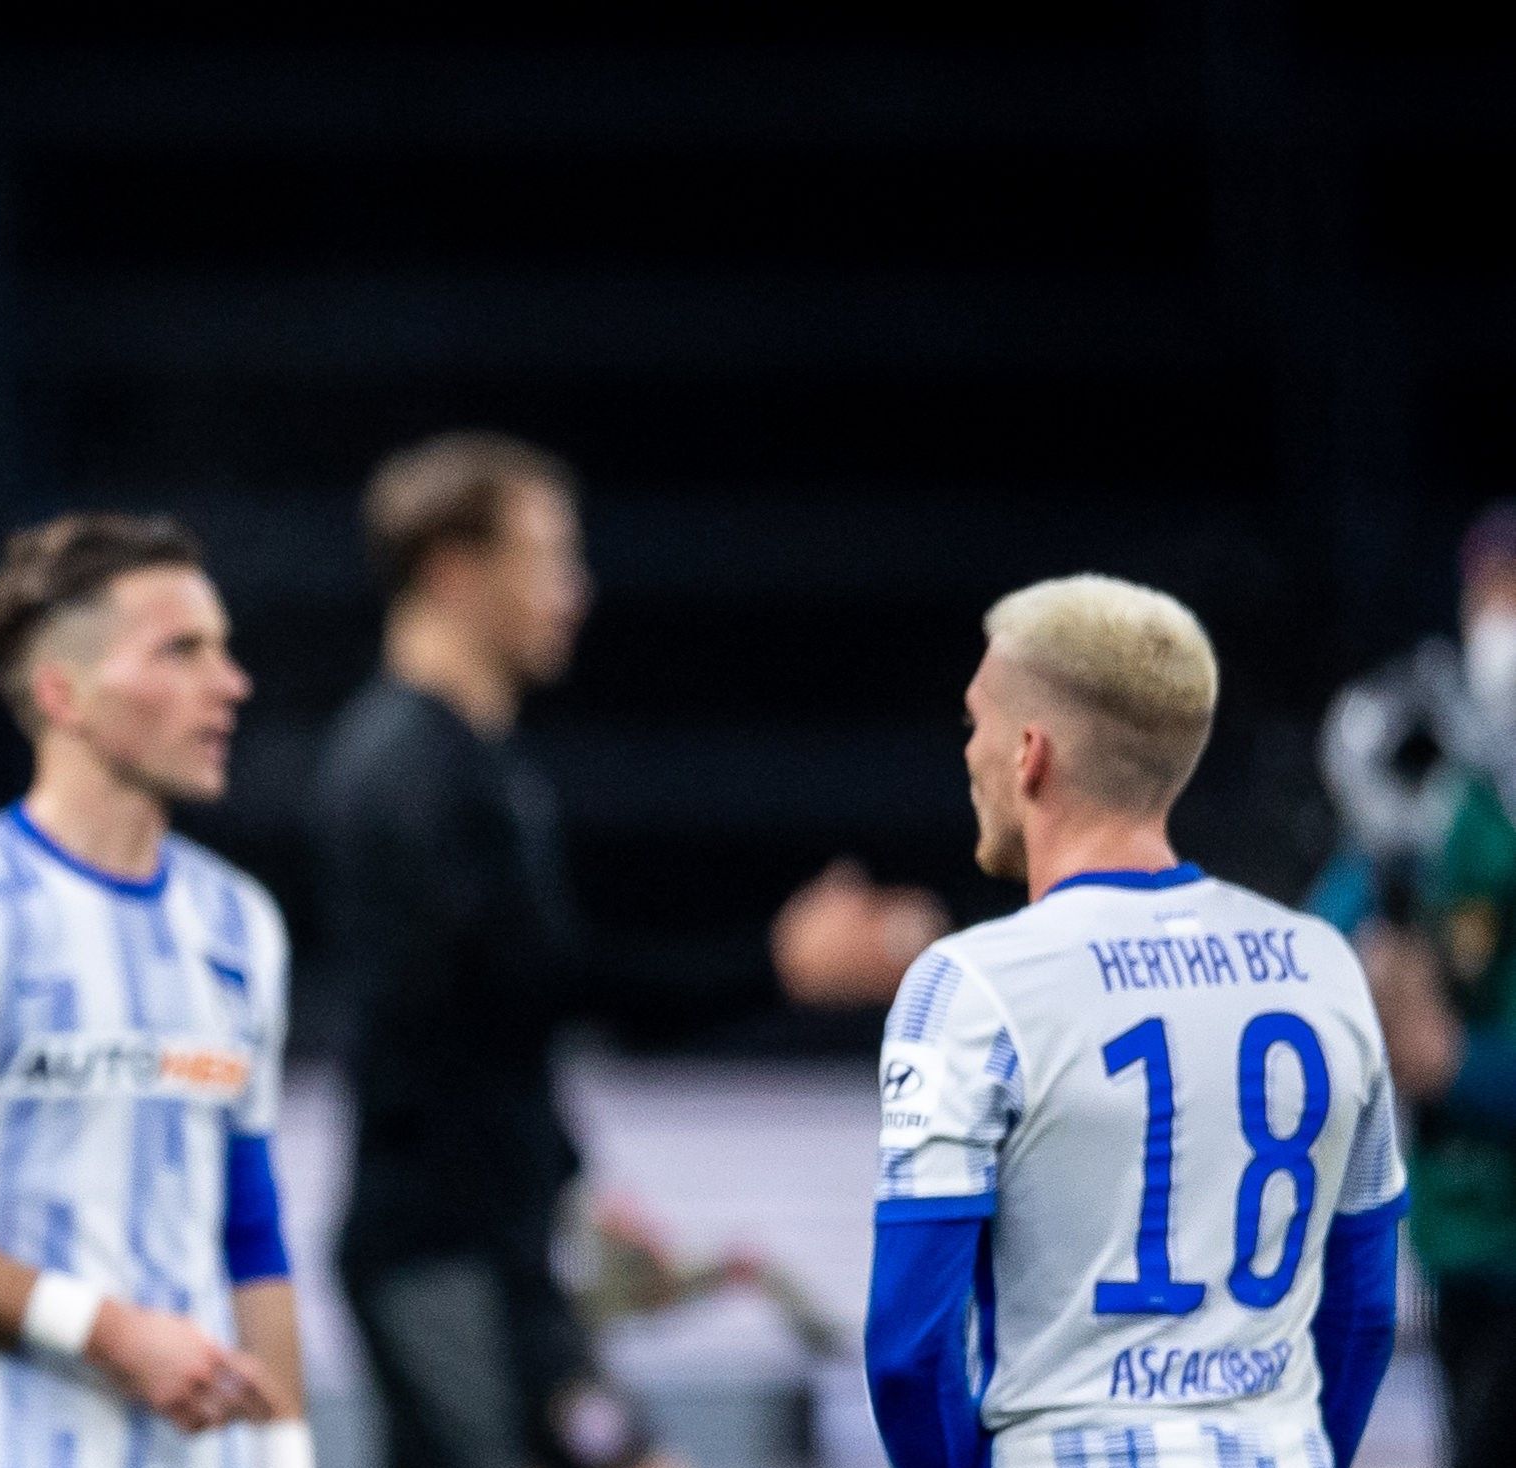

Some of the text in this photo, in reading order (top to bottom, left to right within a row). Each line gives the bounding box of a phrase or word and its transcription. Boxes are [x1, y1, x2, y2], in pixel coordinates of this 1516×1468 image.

[1086, 928, 1310, 992] HERTHA BSC
[1091, 1011, 1331, 1317] 18
